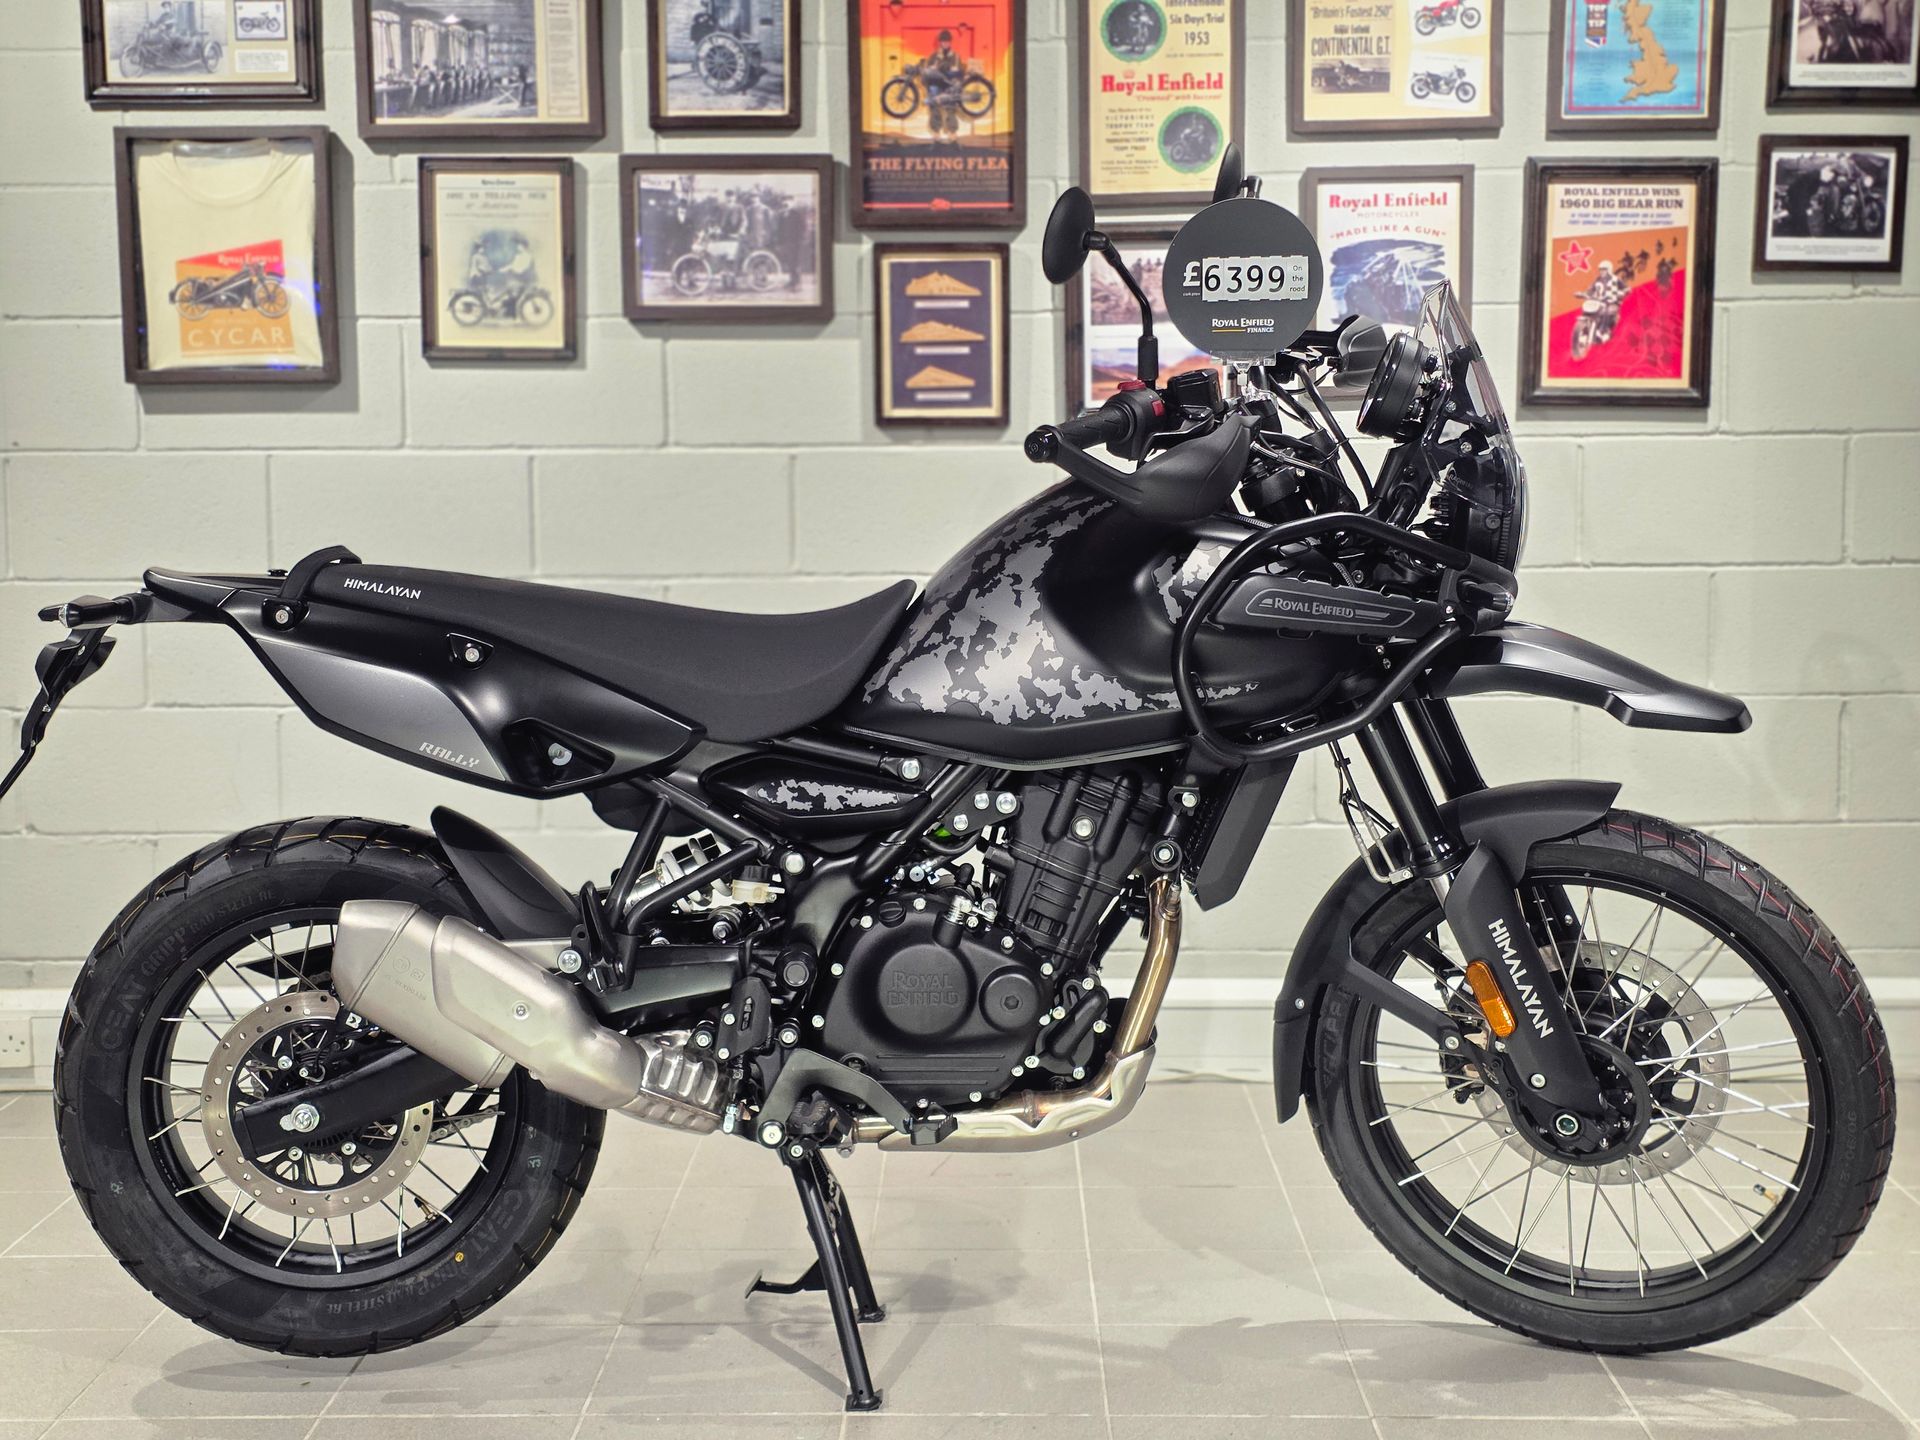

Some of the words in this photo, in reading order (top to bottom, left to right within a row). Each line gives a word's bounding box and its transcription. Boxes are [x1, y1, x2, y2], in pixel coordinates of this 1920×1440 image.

[1169, 14, 1183, 25] Six
[1184, 13, 1206, 26] Days
[1206, 13, 1225, 24] Trial
[1184, 31, 1210, 46] 1953
[1311, 37, 1374, 57] CONTINENTAL
[1101, 73, 1154, 96] Royal
[1158, 72, 1224, 91] Enfield
[869, 156, 902, 171] THE
[904, 156, 964, 171] FLYING
[966, 156, 1010, 171] FLEA
[1564, 187, 1600, 197] ROYAL
[1602, 187, 1649, 197] ENFIELD
[1651, 187, 1681, 197] WINS
[1329, 193, 1378, 212] Royal
[1384, 191, 1448, 207] Enfield
[1560, 198, 1591, 209] 1960
[1592, 198, 1615, 209] BIG
[1618, 198, 1653, 209] BEAR
[1656, 198, 1684, 209] RUN
[1373, 224, 1398, 233] LIKE
[1403, 224, 1411, 232] A
[1292, 264, 1303, 272] On
[1292, 274, 1304, 282] the
[1289, 285, 1306, 293] road
[1212, 318, 1239, 327] ROYAL
[1240, 317, 1275, 327] ENFIELD
[187, 326, 287, 347] CYCAR
[343, 578, 422, 600] HIMALAYAN
[1274, 597, 1311, 613] ROYAL
[1311, 602, 1355, 618] ENFIELD
[419, 741, 480, 768] RALLY
[891, 969, 954, 991] ROYAL
[1488, 918, 1554, 1039] HIMALAYAN
[886, 990, 961, 1008] ENFIELD
